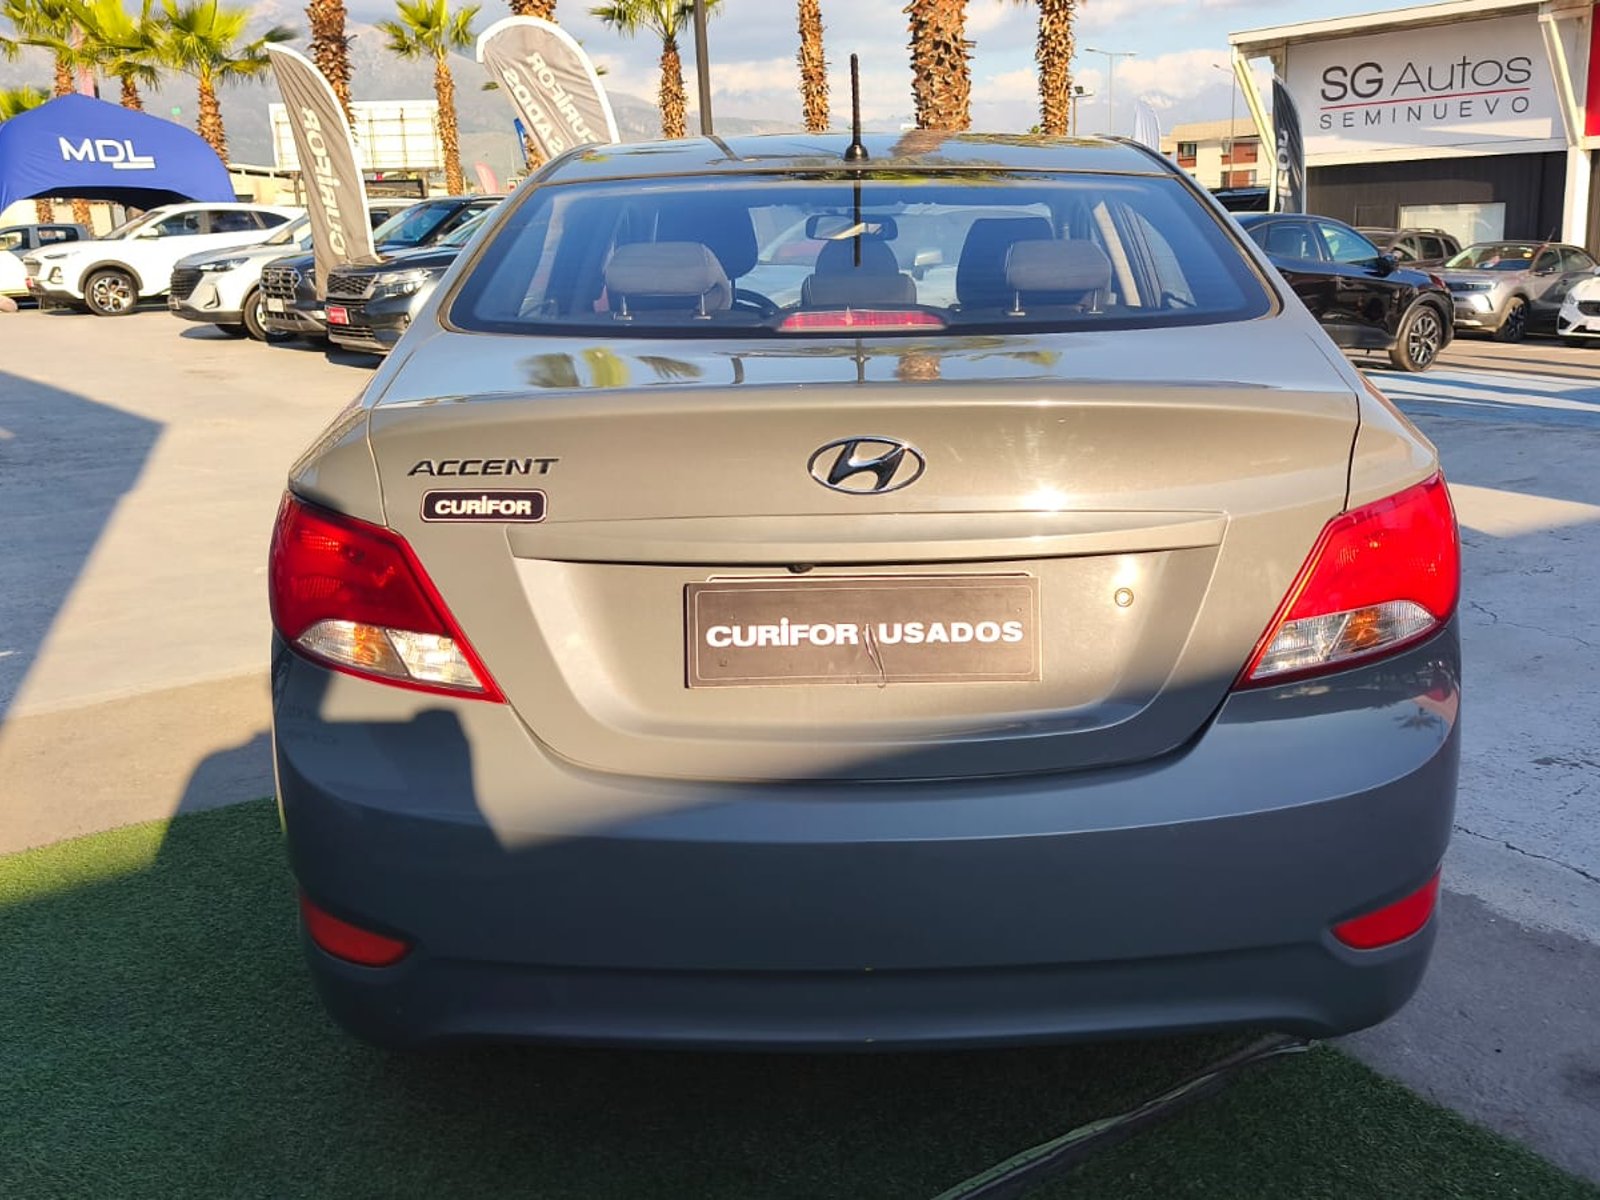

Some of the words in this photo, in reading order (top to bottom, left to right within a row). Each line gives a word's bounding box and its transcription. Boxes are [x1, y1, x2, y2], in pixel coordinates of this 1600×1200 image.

[1320, 61, 1384, 103] SG
[1390, 55, 1533, 97] Autos
[1319, 96, 1530, 130] SEMINUEVO
[58, 136, 156, 169] MDL
[407, 458, 559, 477] ACCENT
[878, 621, 1024, 644] USADOS
